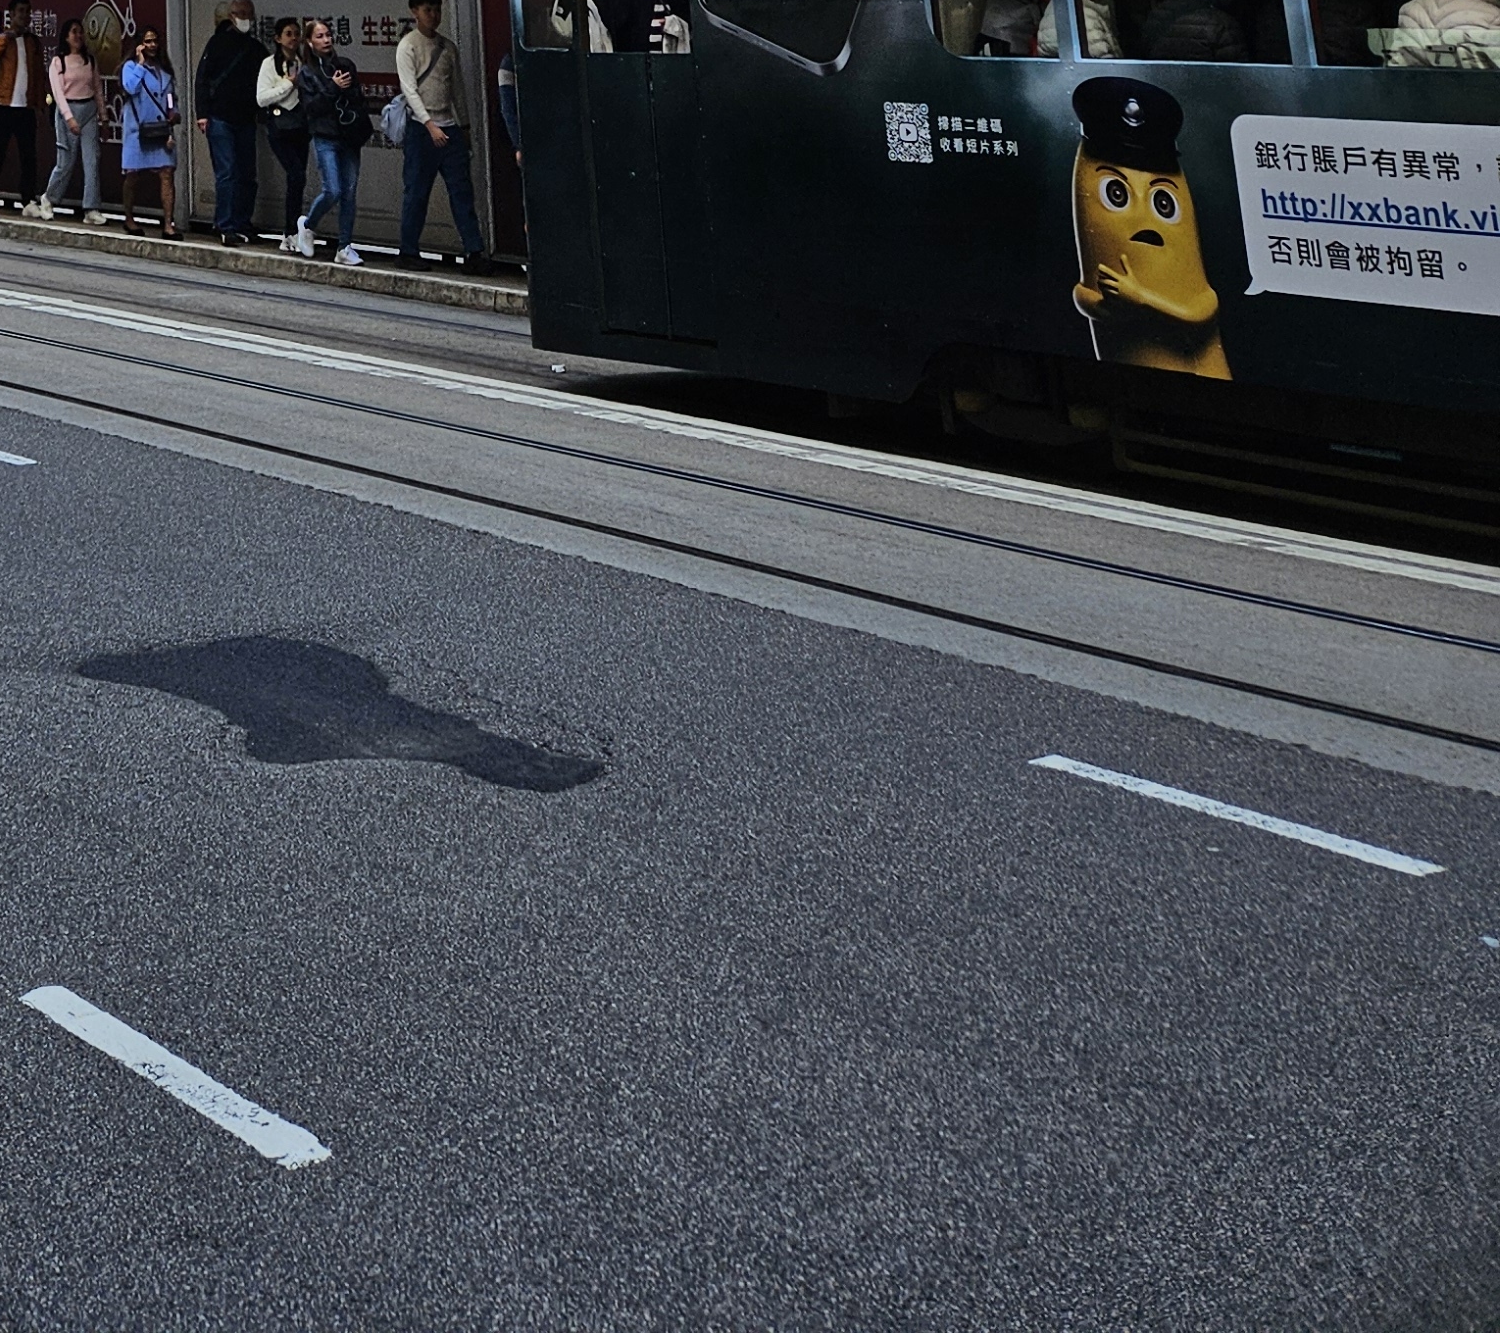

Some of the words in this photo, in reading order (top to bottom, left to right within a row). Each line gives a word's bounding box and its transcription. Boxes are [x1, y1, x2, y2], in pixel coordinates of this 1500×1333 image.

[937, 116, 1003, 133] 掃描二維碼
[939, 137, 1019, 156] 收看短片系列
